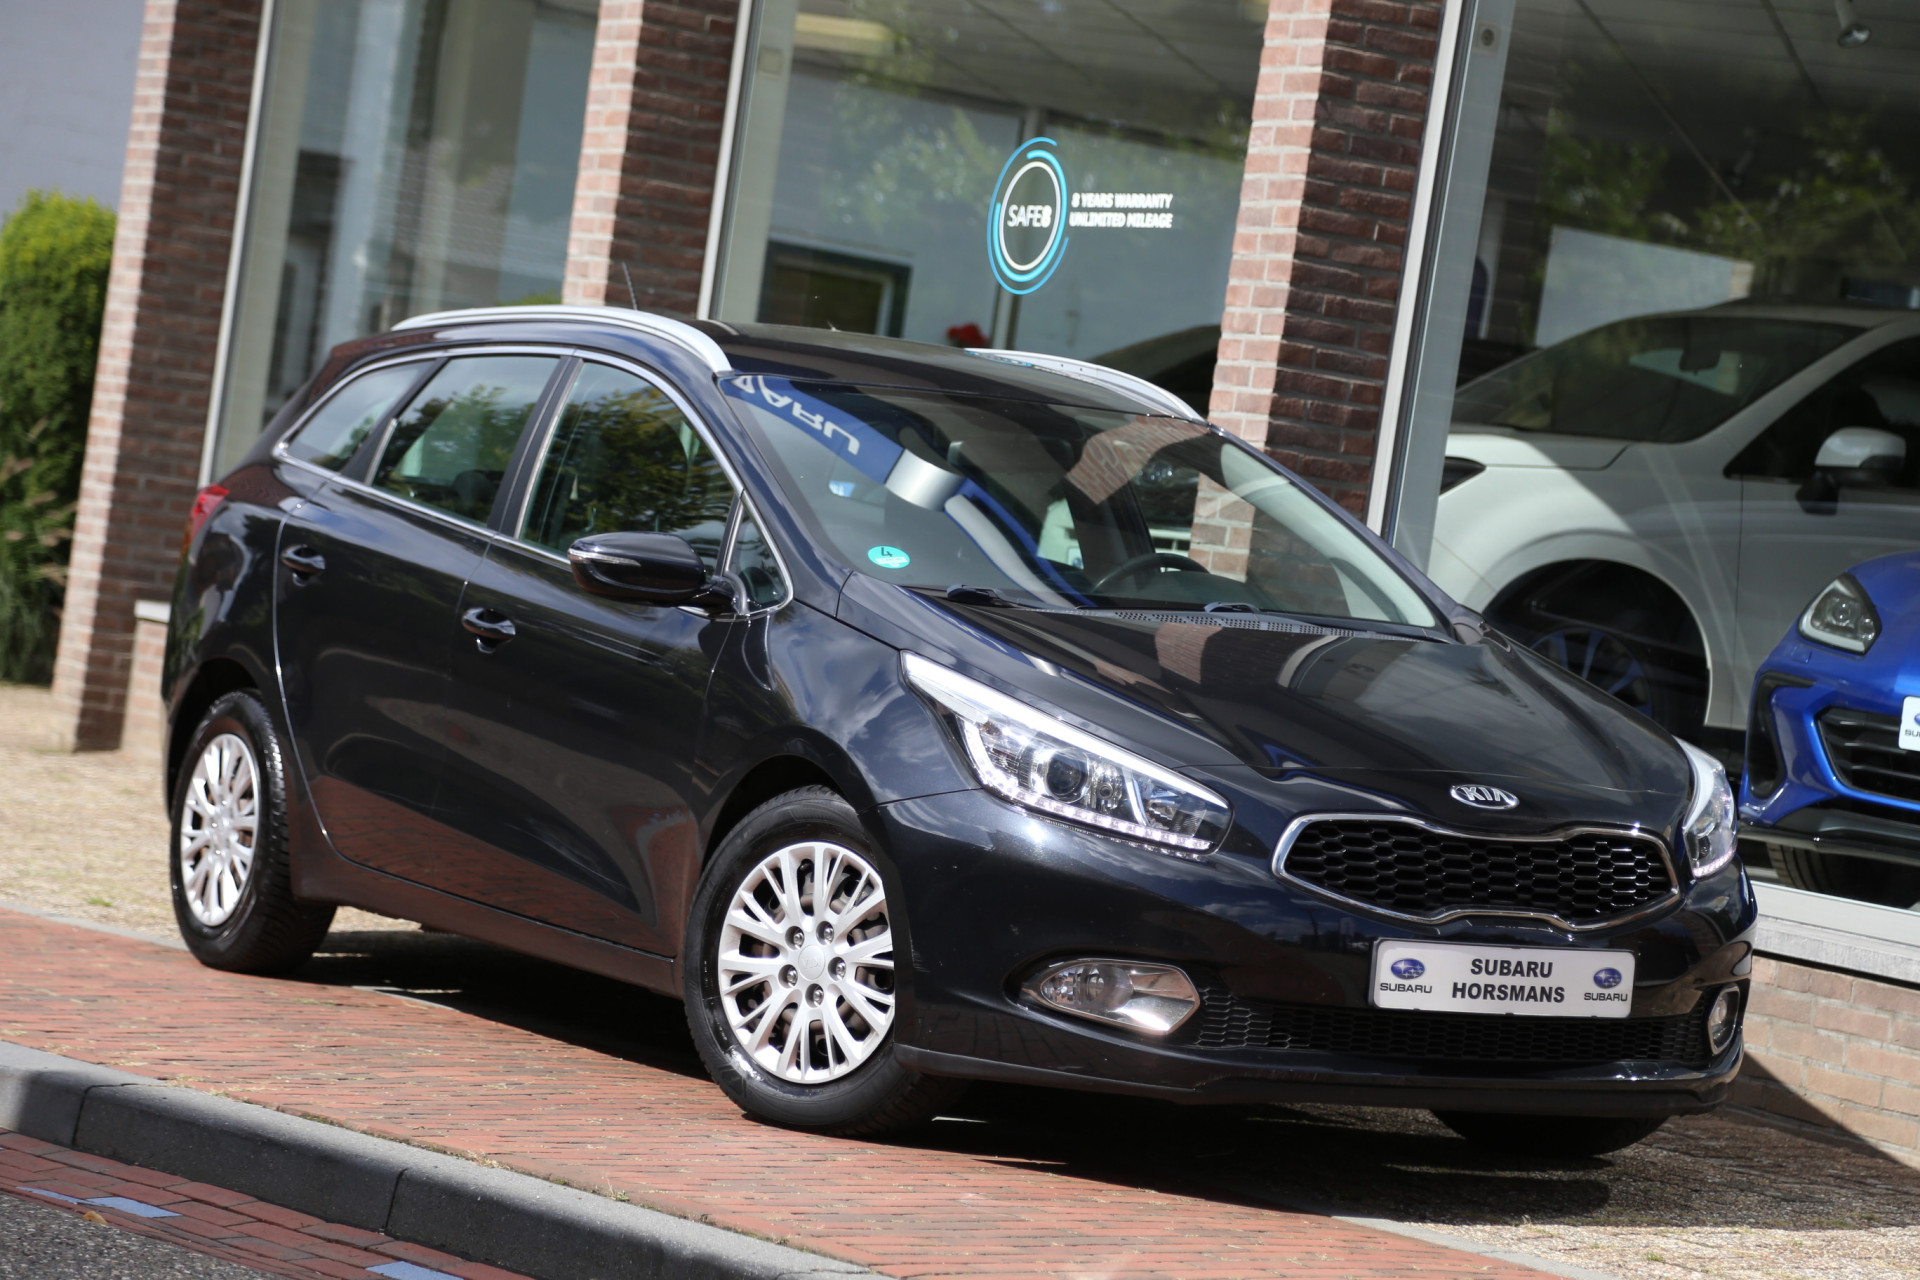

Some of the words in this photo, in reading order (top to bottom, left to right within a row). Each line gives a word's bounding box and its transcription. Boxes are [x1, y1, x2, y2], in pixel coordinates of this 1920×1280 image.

[1081, 192, 1114, 208] YEARS
[1115, 193, 1173, 209] WARRANTY
[1007, 204, 1052, 228] SAFE8
[1069, 211, 1126, 228] UNLIMITED
[1126, 212, 1173, 229] MILEAGE
[1459, 786, 1517, 807] KIA
[1470, 958, 1553, 979] SUBARU
[1379, 982, 1433, 994] SUBARU
[1451, 981, 1566, 1004] HORSMANS
[1583, 992, 1629, 1003] SUBARU
